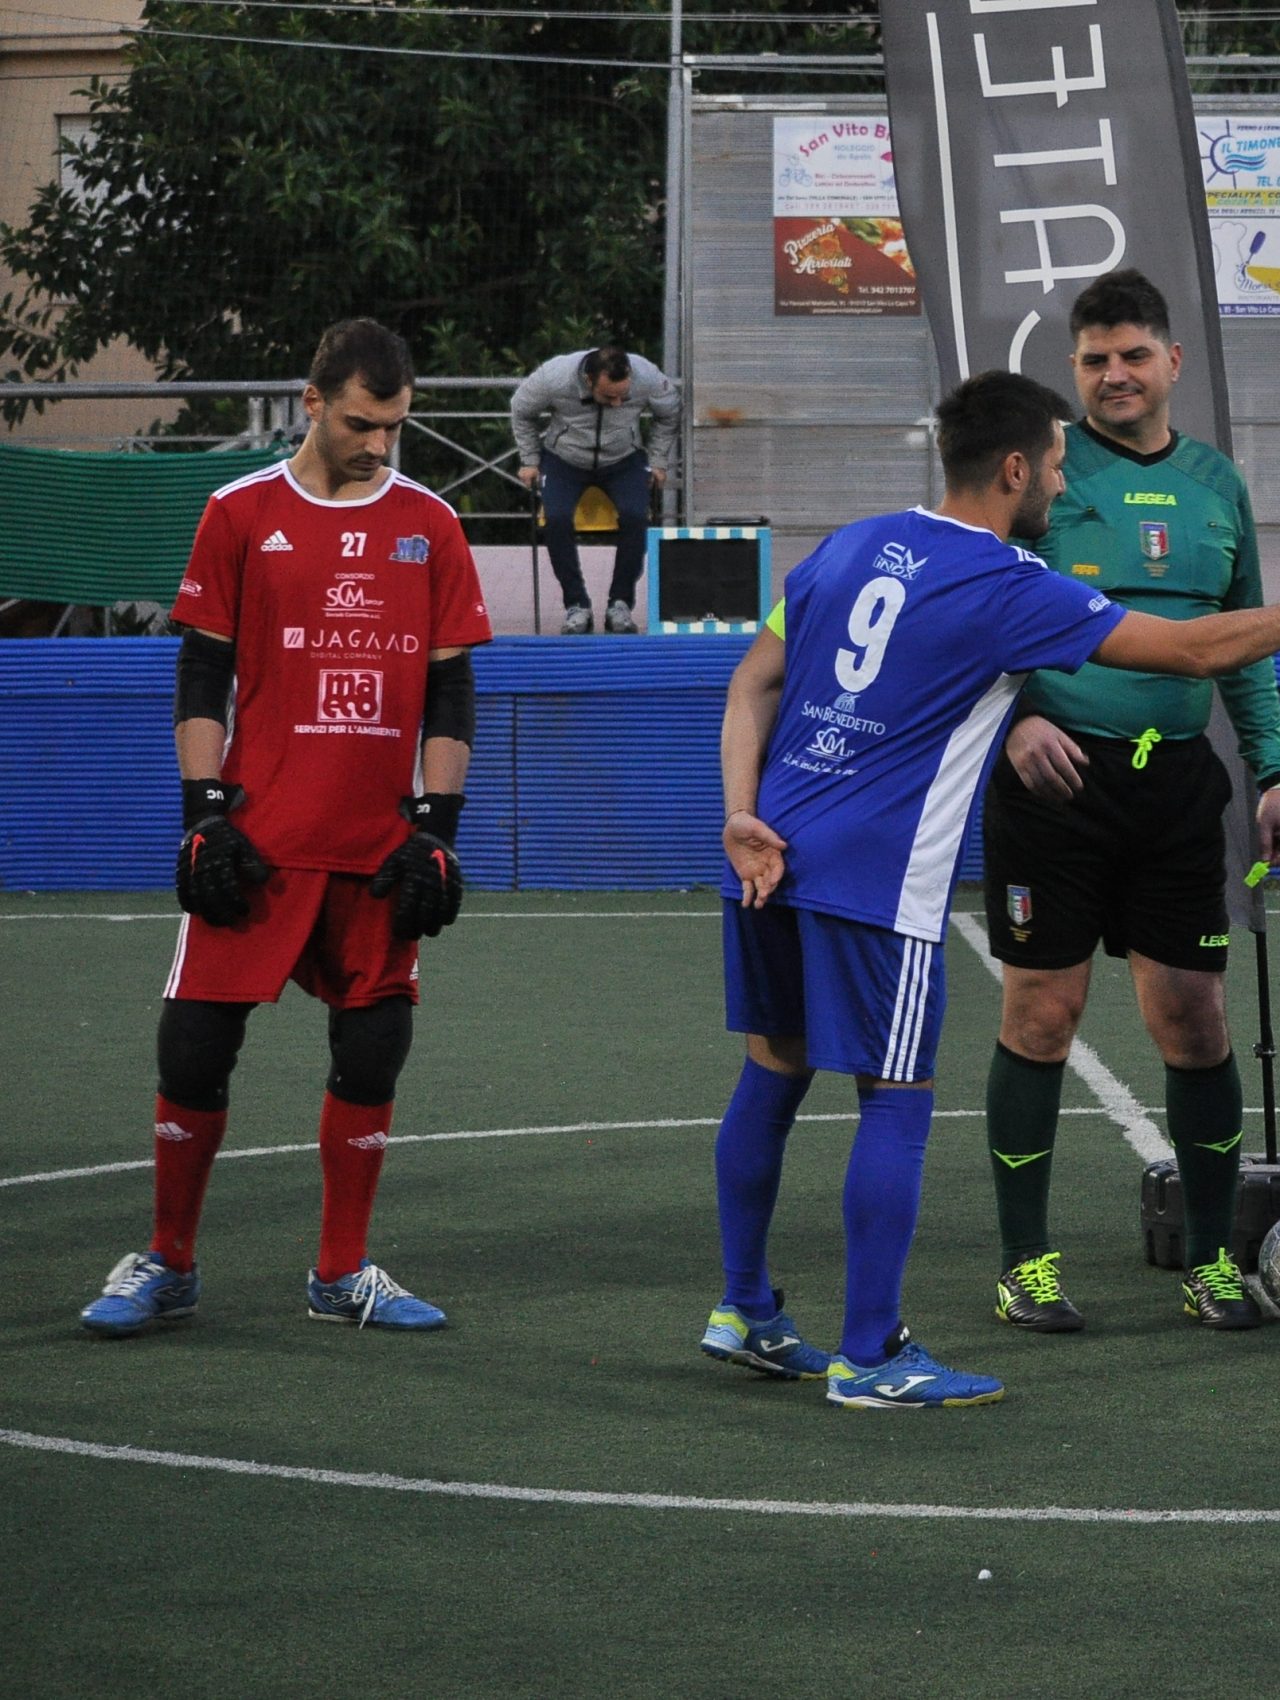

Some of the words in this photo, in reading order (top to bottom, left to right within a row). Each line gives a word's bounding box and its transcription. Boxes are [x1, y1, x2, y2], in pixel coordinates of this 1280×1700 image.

[799, 133, 829, 158] San
[832, 123, 868, 138] Vito
[1221, 143, 1232, 153] IL
[784, 222, 837, 265] Pizzeria
[858, 286, 869, 294] Tel.
[1123, 492, 1177, 506] LEGEA
[260, 543, 294, 552] adidas
[341, 532, 368, 557] 27
[334, 572, 376, 580] CONSORZIO
[326, 581, 366, 608] SCM
[834, 576, 906, 693] 9
[310, 651, 342, 660] DIGITAL
[343, 652, 383, 661] COMPANY
[294, 724, 327, 734] SERVIZI
[328, 725, 347, 734] PER
[347, 725, 401, 738] L'AMBIENTE
